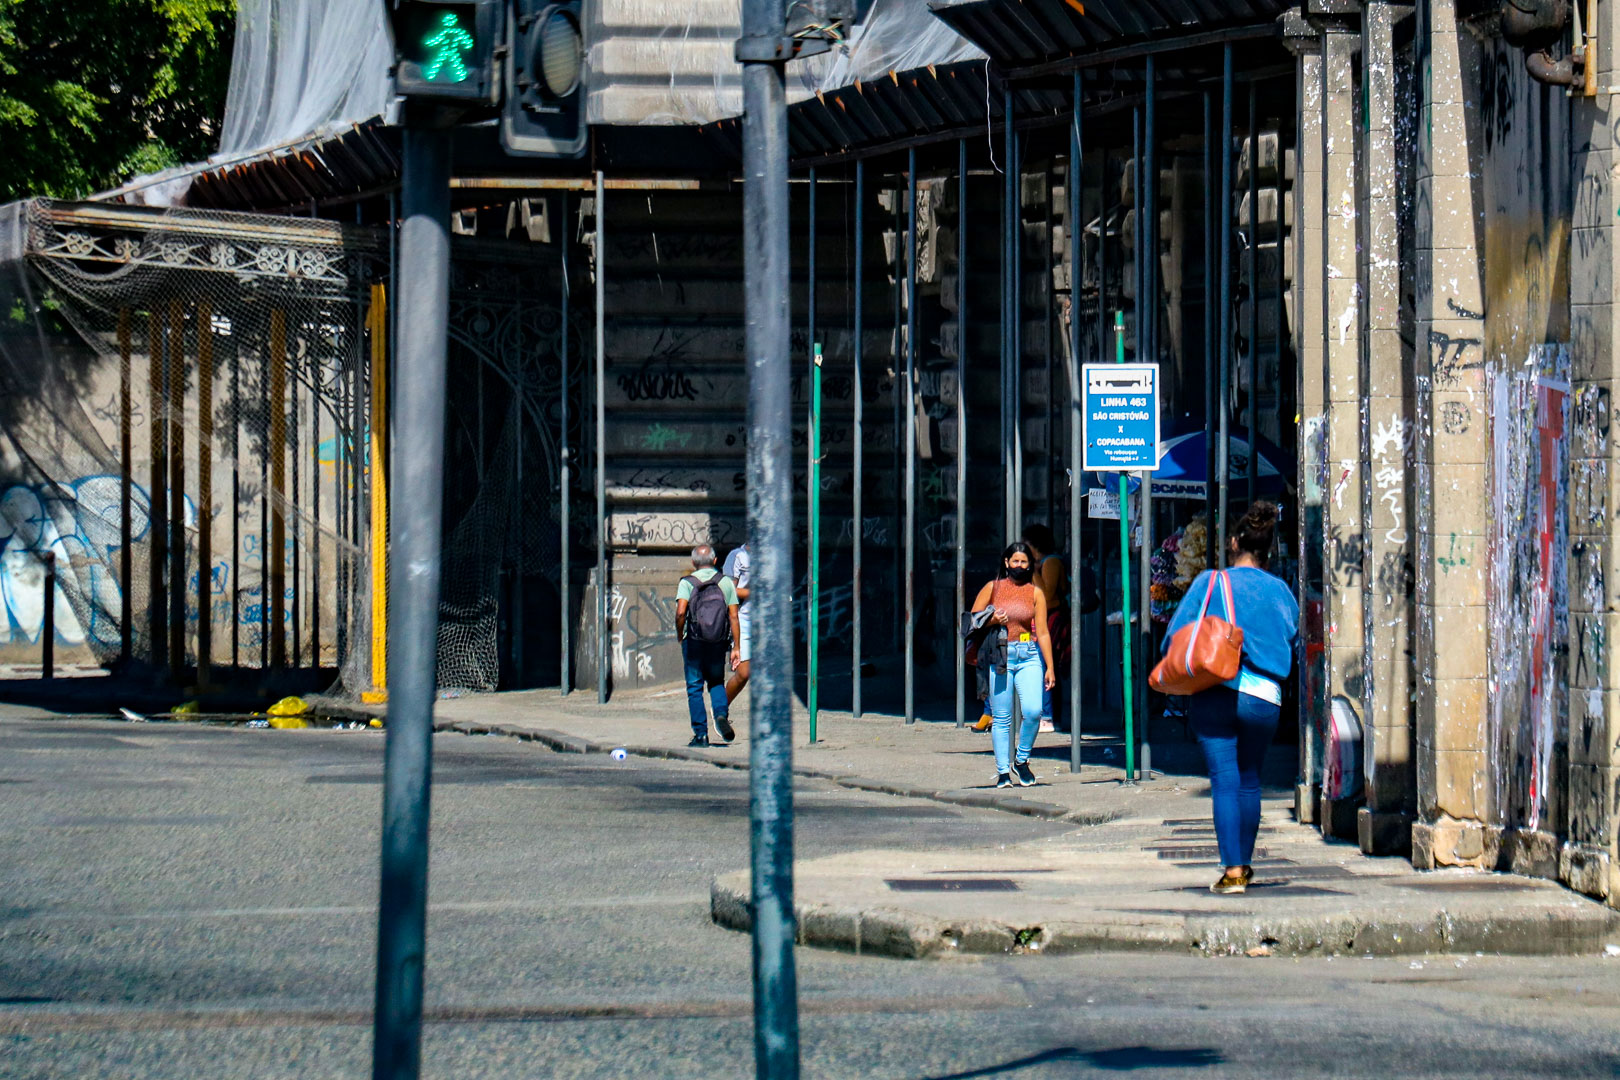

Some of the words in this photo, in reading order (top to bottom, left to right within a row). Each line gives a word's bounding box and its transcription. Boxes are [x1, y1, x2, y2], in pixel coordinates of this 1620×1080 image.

[1100, 398, 1128, 406] LINHA
[1130, 398, 1146, 406] 463
[1092, 411, 1108, 420] SÃO
[1109, 411, 1149, 420] CRISTÓVÃO
[1096, 438, 1145, 446] COPACABANA
[1151, 483, 1206, 496] SCANIA
